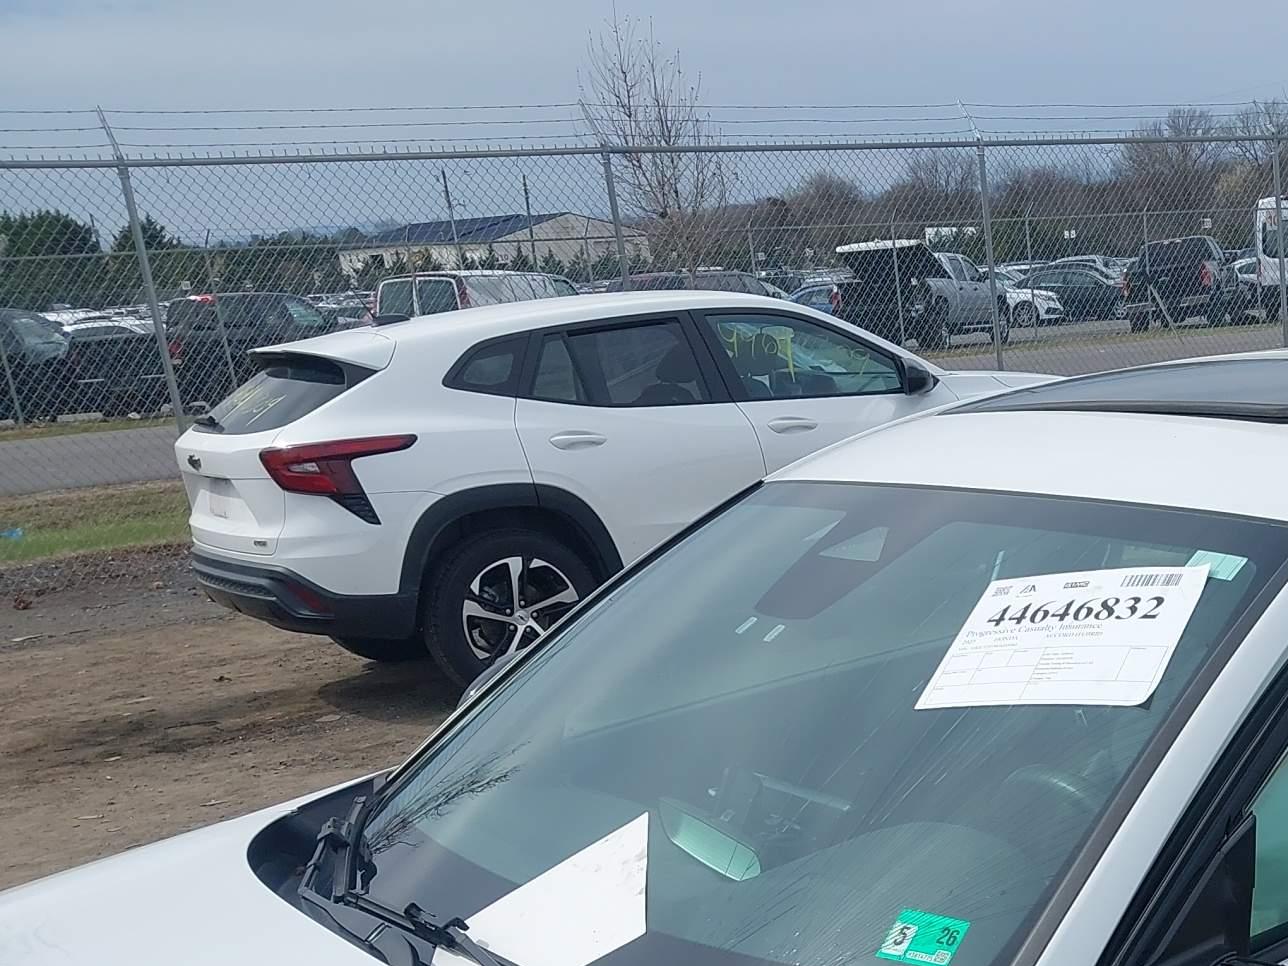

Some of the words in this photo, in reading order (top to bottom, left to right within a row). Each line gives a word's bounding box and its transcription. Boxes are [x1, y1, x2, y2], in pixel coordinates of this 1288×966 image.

[987, 596, 1165, 627] 44646832
[1018, 624, 1057, 633] Casualty
[893, 926, 911, 946] 5
[935, 926, 961, 947] 26
